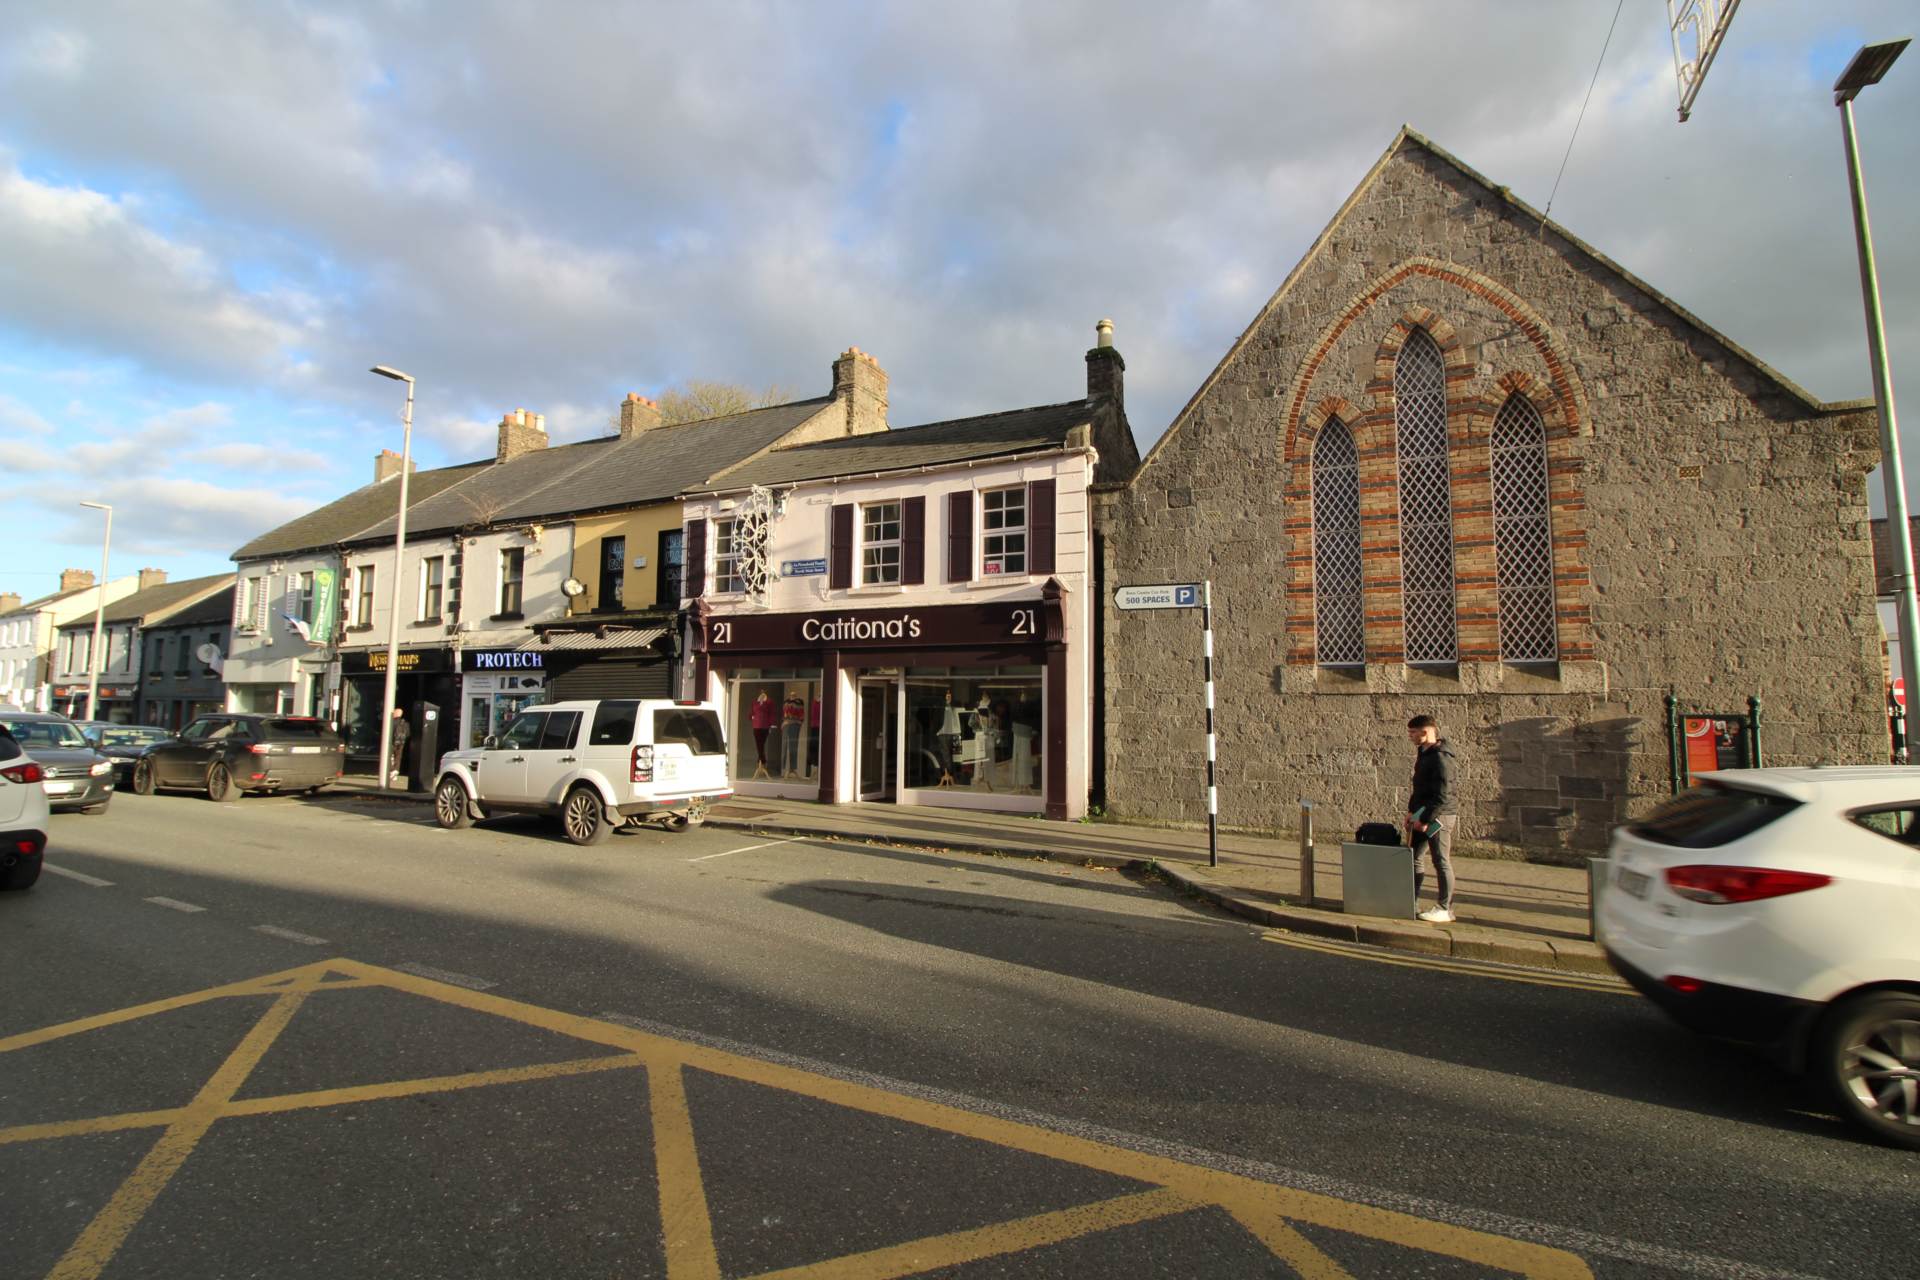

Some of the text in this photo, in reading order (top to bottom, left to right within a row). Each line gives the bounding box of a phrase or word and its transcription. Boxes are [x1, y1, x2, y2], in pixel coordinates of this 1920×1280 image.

[1142, 596, 1170, 604] SPACES
[1181, 590, 1190, 602] P
[802, 614, 921, 641] Catriona's
[1012, 609, 1036, 634] 21
[713, 622, 731, 644] 21
[476, 652, 544, 668] PROTECH
